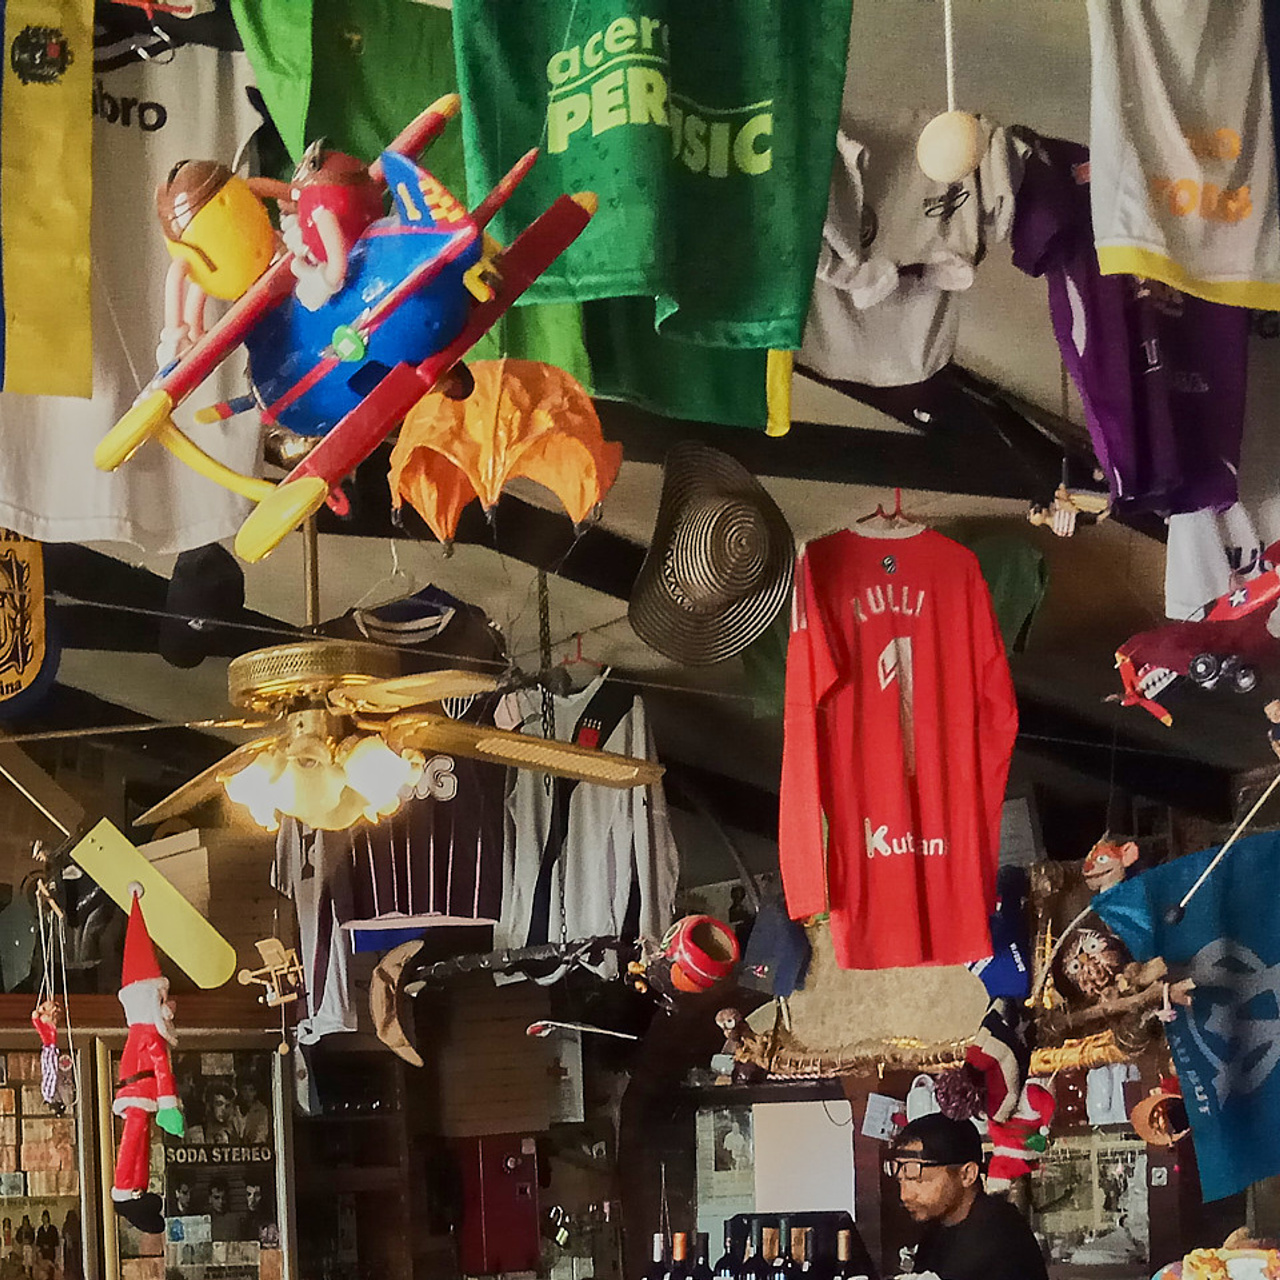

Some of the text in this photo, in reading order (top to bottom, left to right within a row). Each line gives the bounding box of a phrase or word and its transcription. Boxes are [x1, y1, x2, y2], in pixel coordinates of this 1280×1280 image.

[93, 77, 168, 132] bro
[166, 1147, 272, 1163] SODA STEREO
